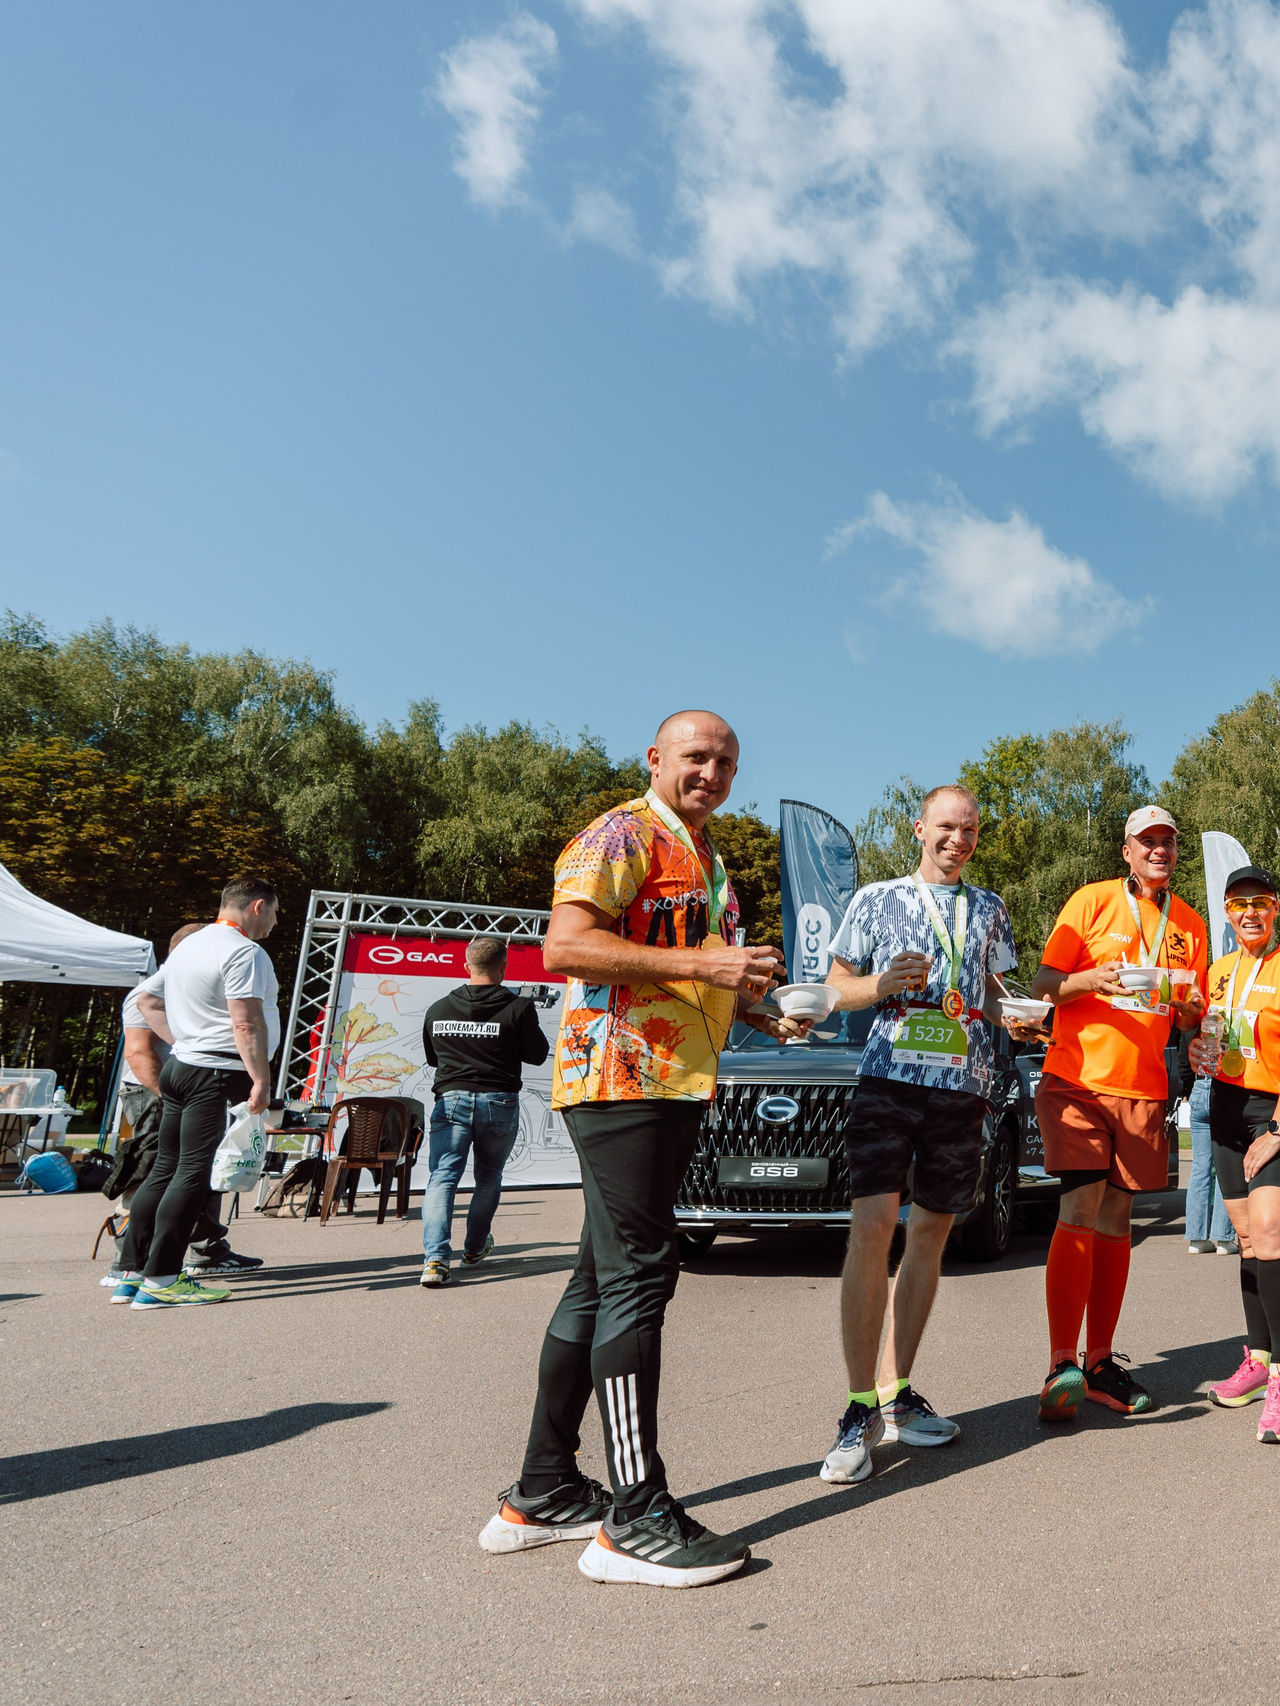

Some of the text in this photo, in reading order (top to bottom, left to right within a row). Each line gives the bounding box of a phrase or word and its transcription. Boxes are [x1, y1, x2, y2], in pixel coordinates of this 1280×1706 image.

[406, 952, 454, 964] GAC
[445, 1022, 497, 1033] CINEMA71.RU
[914, 1025, 954, 1044] 5237
[750, 1166, 798, 1177] GS8
